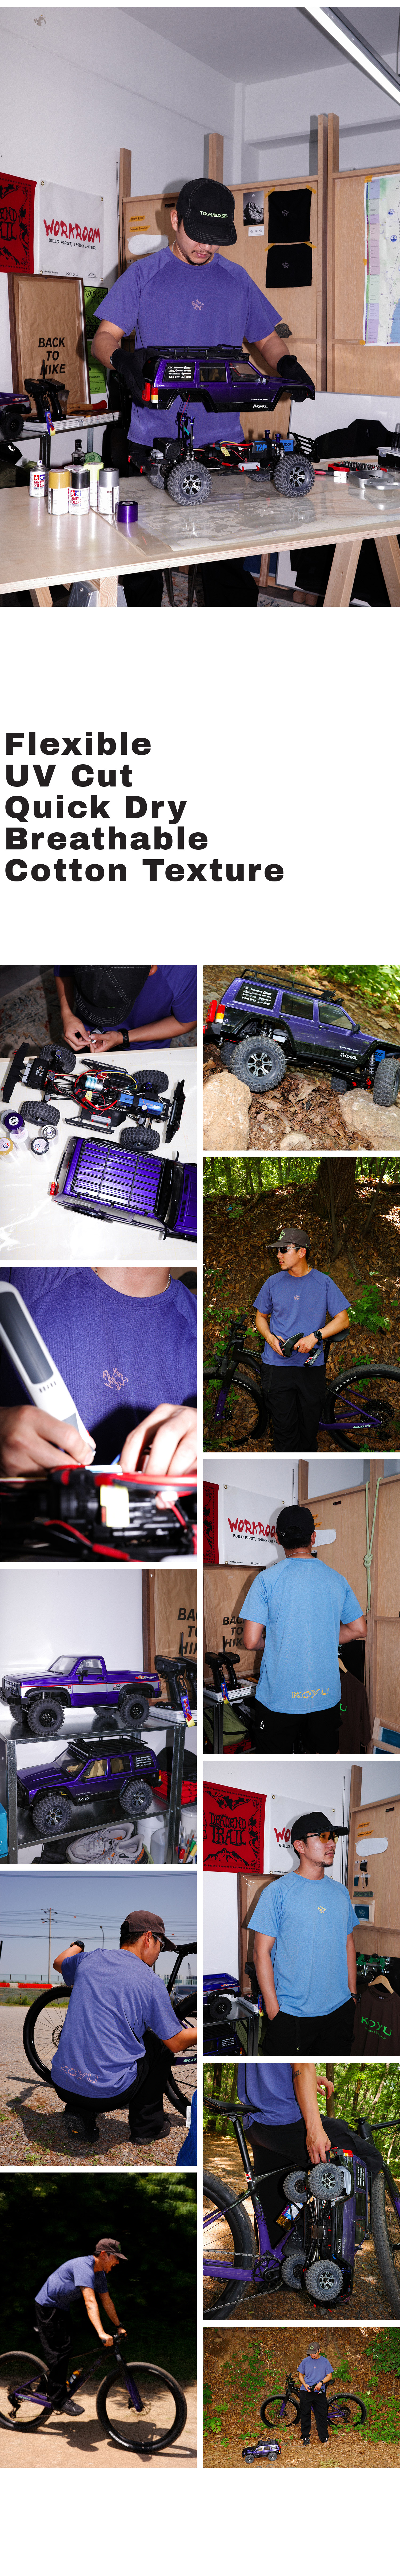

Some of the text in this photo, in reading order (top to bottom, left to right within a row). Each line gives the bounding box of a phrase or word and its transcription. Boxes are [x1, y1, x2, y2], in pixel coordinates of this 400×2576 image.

[43, 219, 101, 243] WORKROOM
[85, 288, 107, 299] WORK
[38, 337, 65, 348] BACK
[46, 350, 59, 361] TO
[40, 364, 66, 375] HIKE
[335, 1376, 357, 1391] MAXXIS
[227, 1517, 277, 1538] WORKROO
[177, 1607, 197, 1621] BA
[231, 1627, 243, 1636] TO
[225, 1638, 243, 1648] HIK
[292, 1688, 329, 1699] KOYU
[209, 1824, 246, 1846] TRAIL
[361, 2016, 392, 2036] KOYU
[61, 2064, 98, 2083] KOYU
